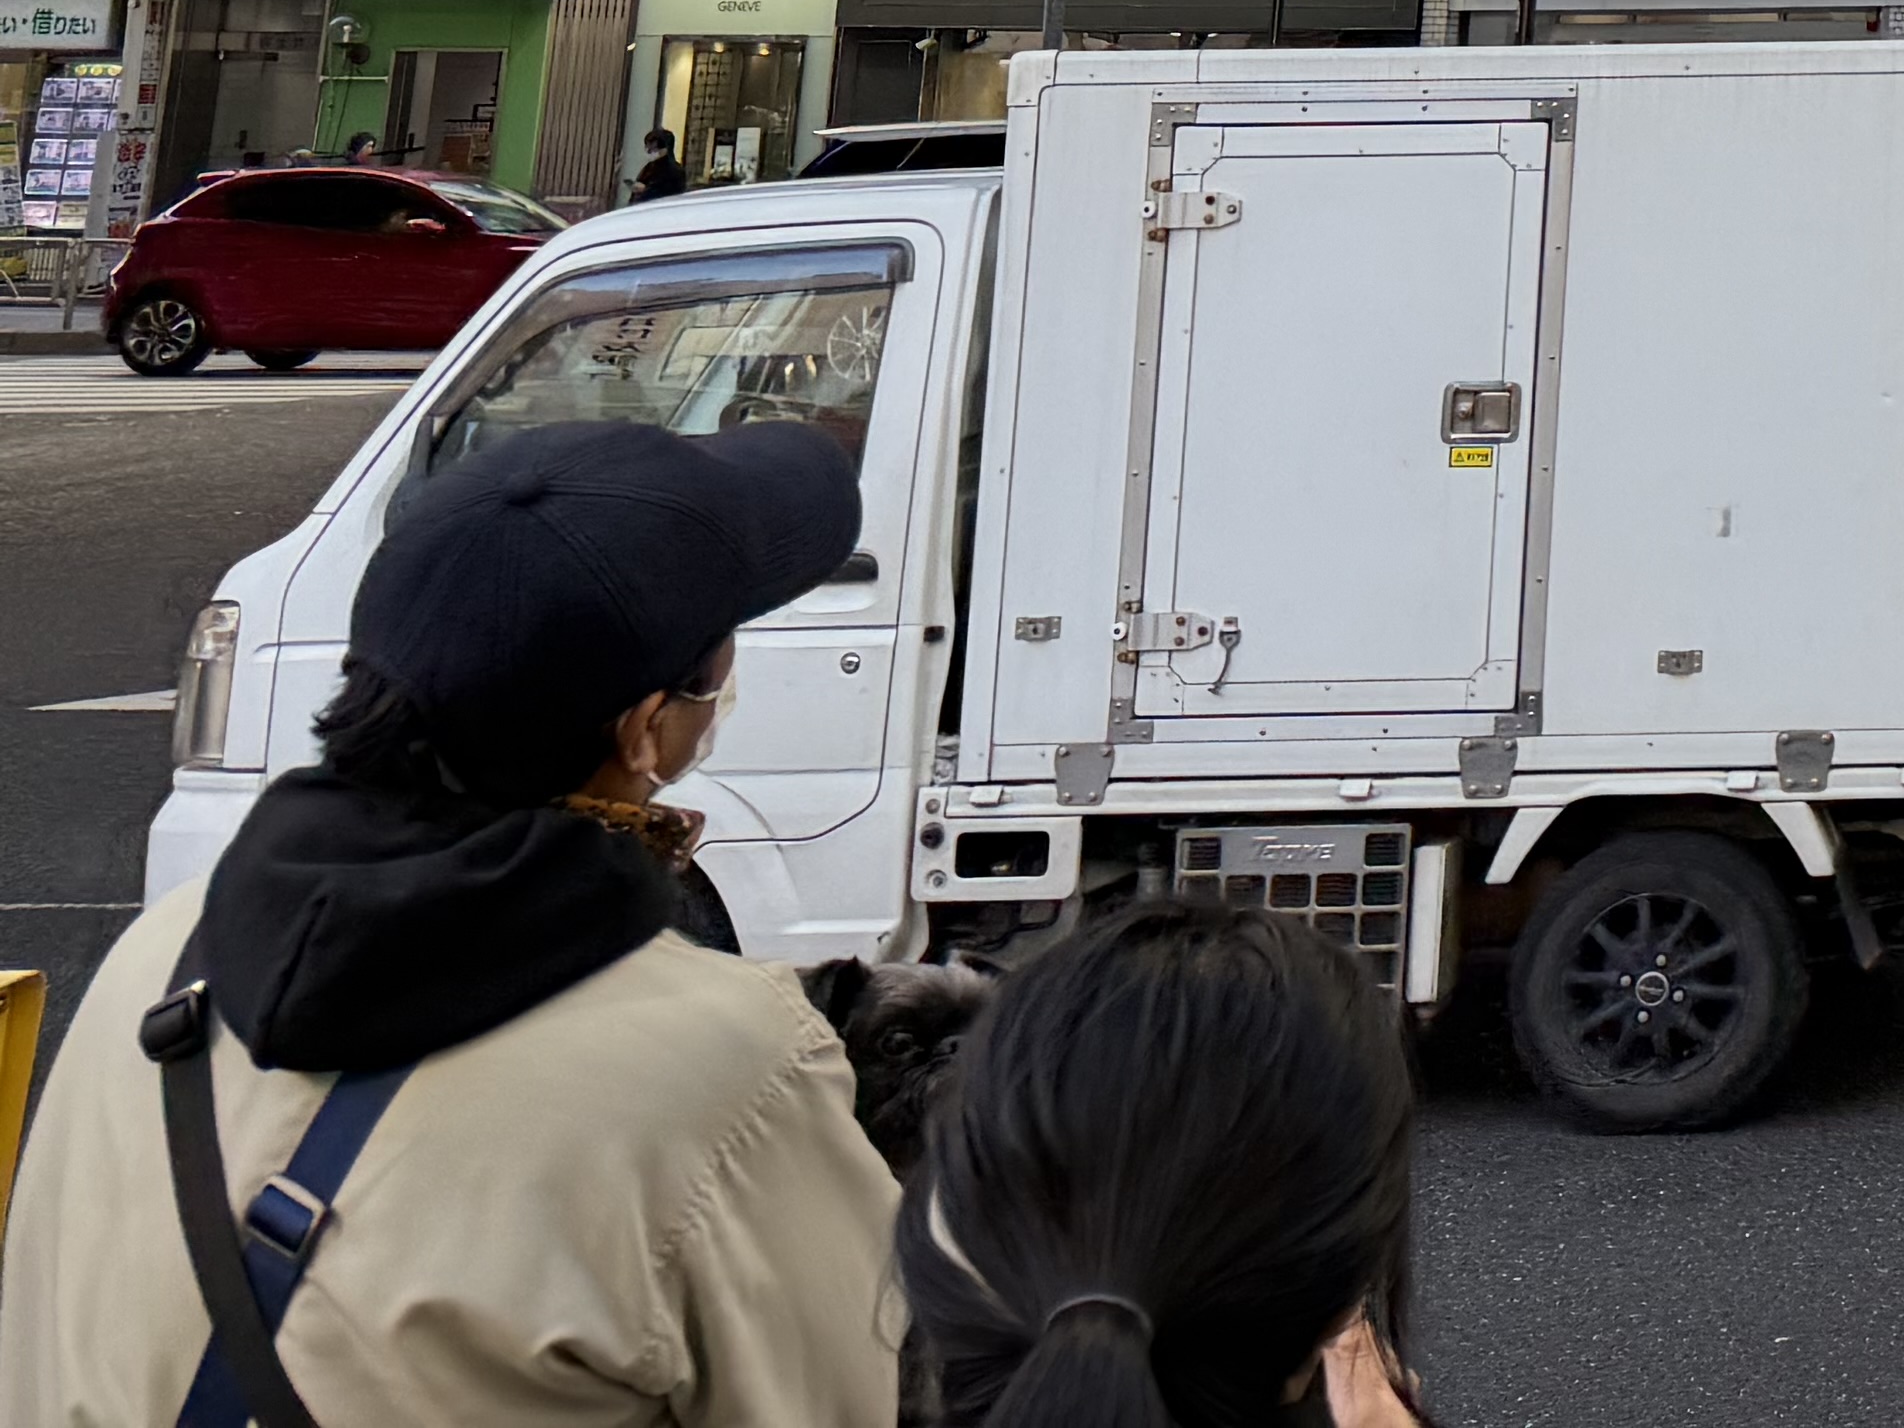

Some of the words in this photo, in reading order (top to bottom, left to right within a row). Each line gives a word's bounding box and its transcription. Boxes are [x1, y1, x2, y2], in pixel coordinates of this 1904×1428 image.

[0, 8, 96, 35] い・借りたい
